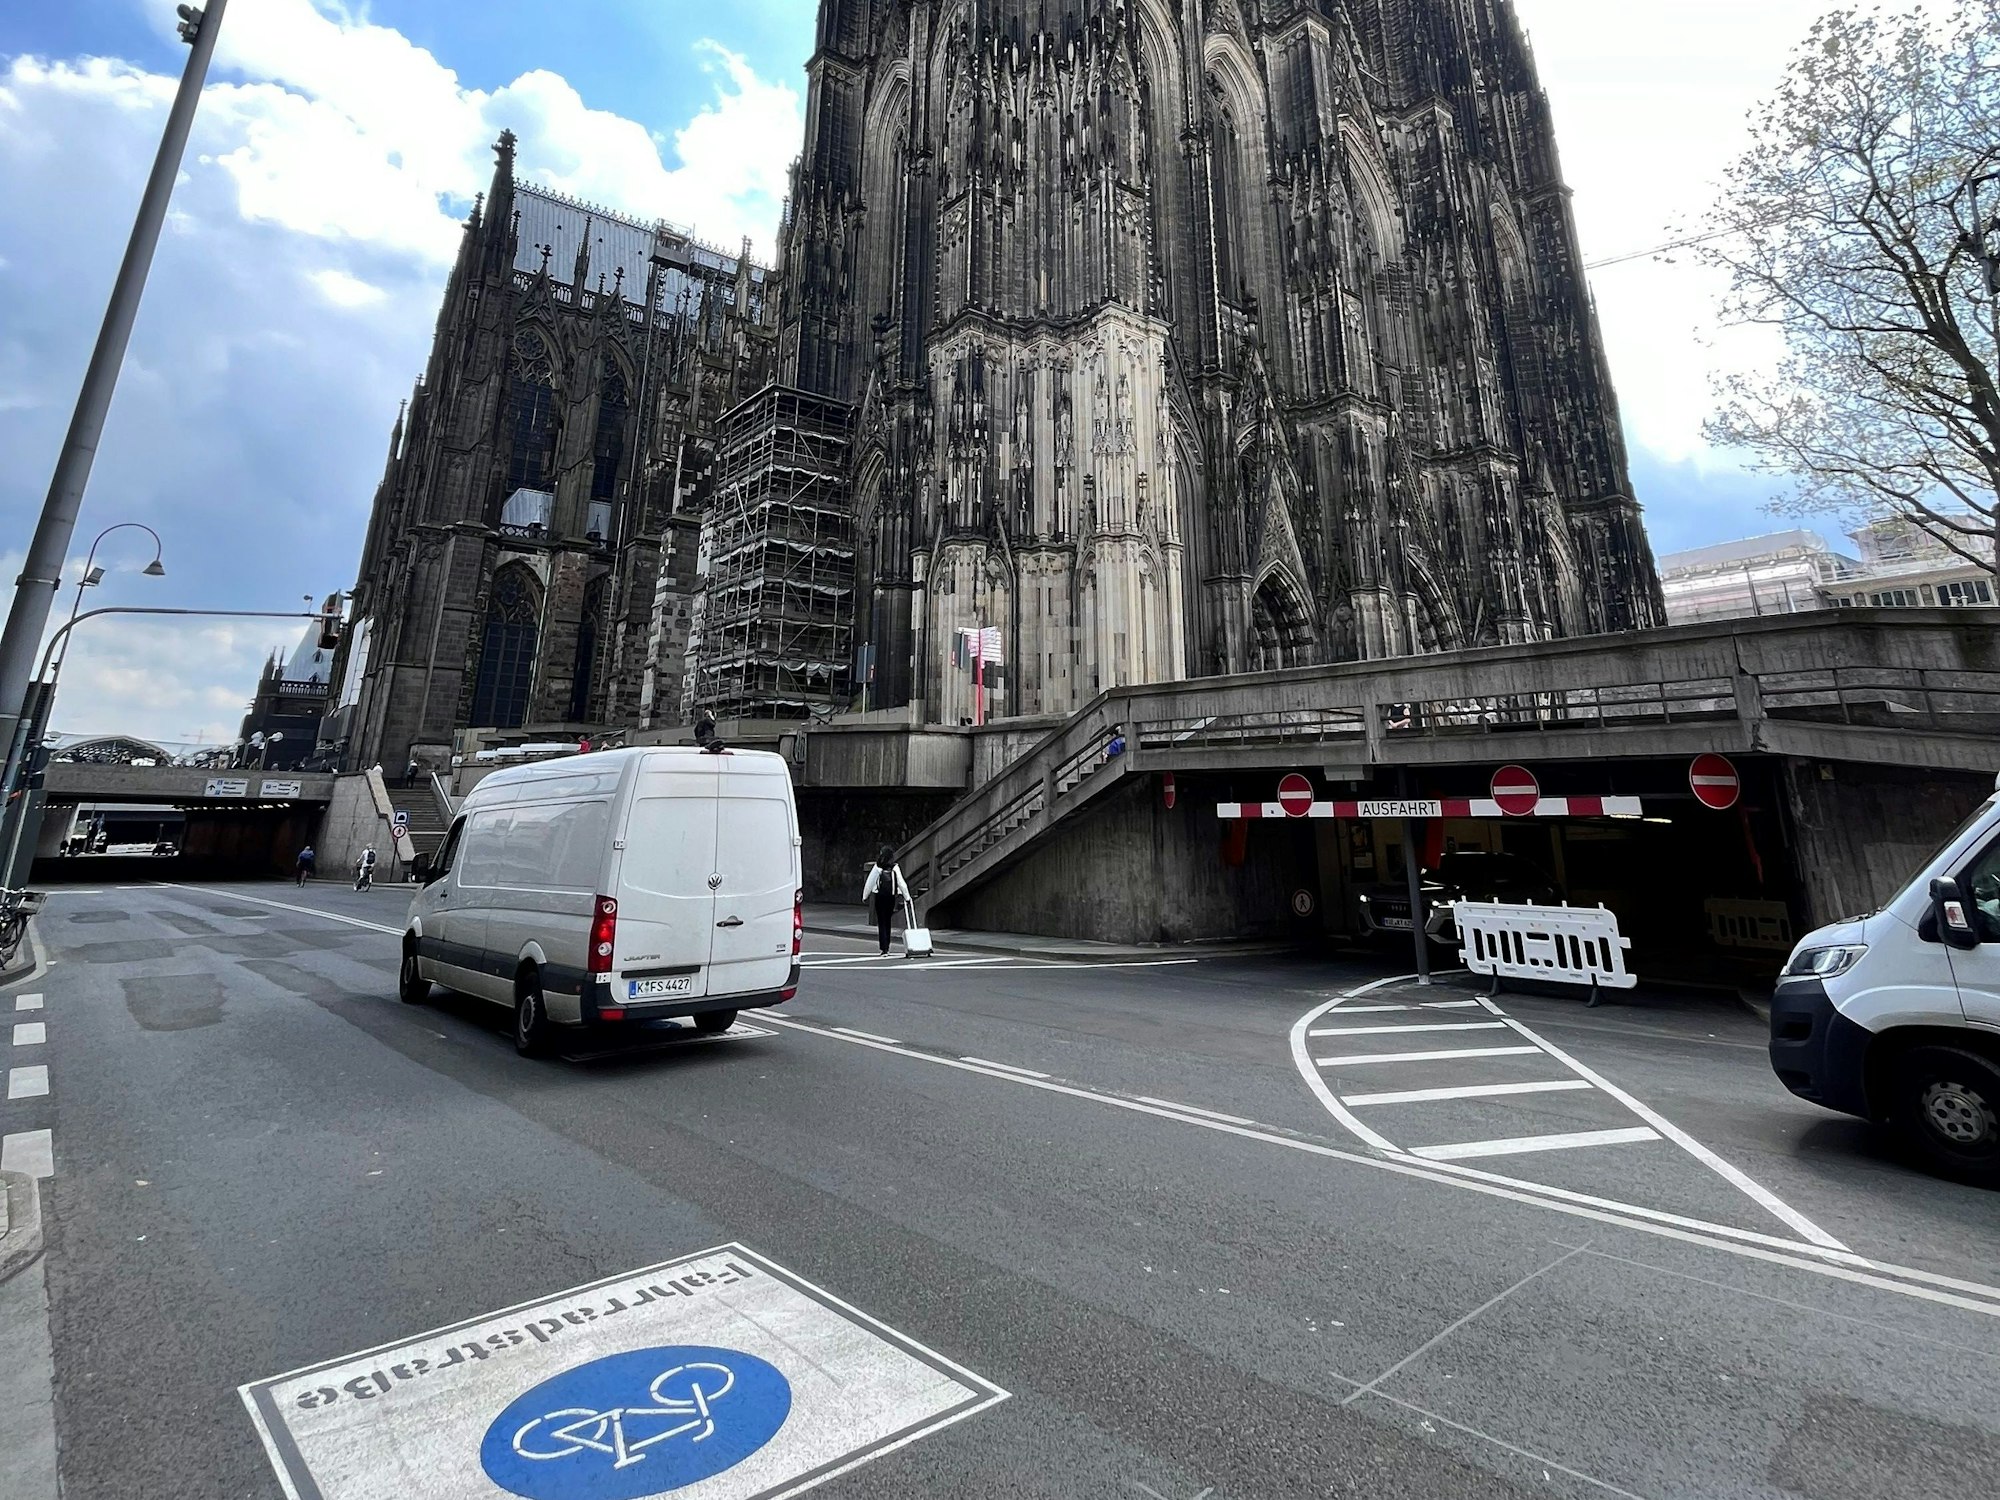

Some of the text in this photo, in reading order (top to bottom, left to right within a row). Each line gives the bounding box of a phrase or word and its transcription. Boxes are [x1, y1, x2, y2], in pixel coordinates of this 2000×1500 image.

[1362, 802, 1436, 815] AUSFAHRT
[665, 979, 690, 990] 4427
[297, 1262, 753, 1409] Fahrradstraße
